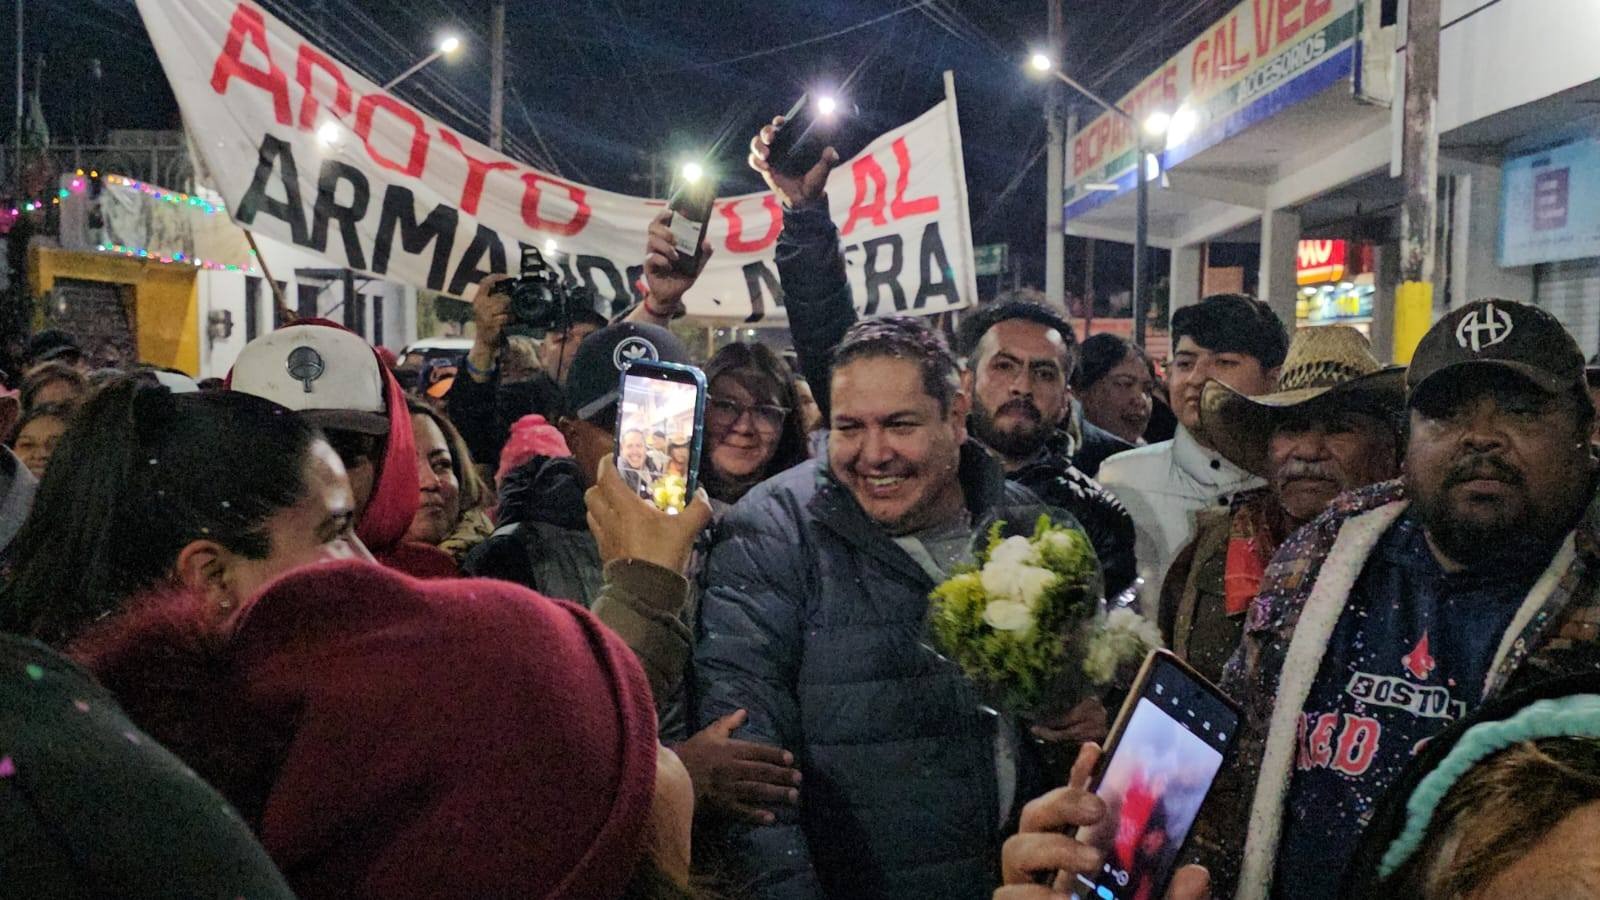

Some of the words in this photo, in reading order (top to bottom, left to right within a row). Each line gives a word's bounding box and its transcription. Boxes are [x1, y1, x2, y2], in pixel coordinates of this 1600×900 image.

[210, 3, 592, 237] APOYO
[1237, 30, 1327, 102] ACCESORIOS
[235, 133, 646, 312] ARMAND
